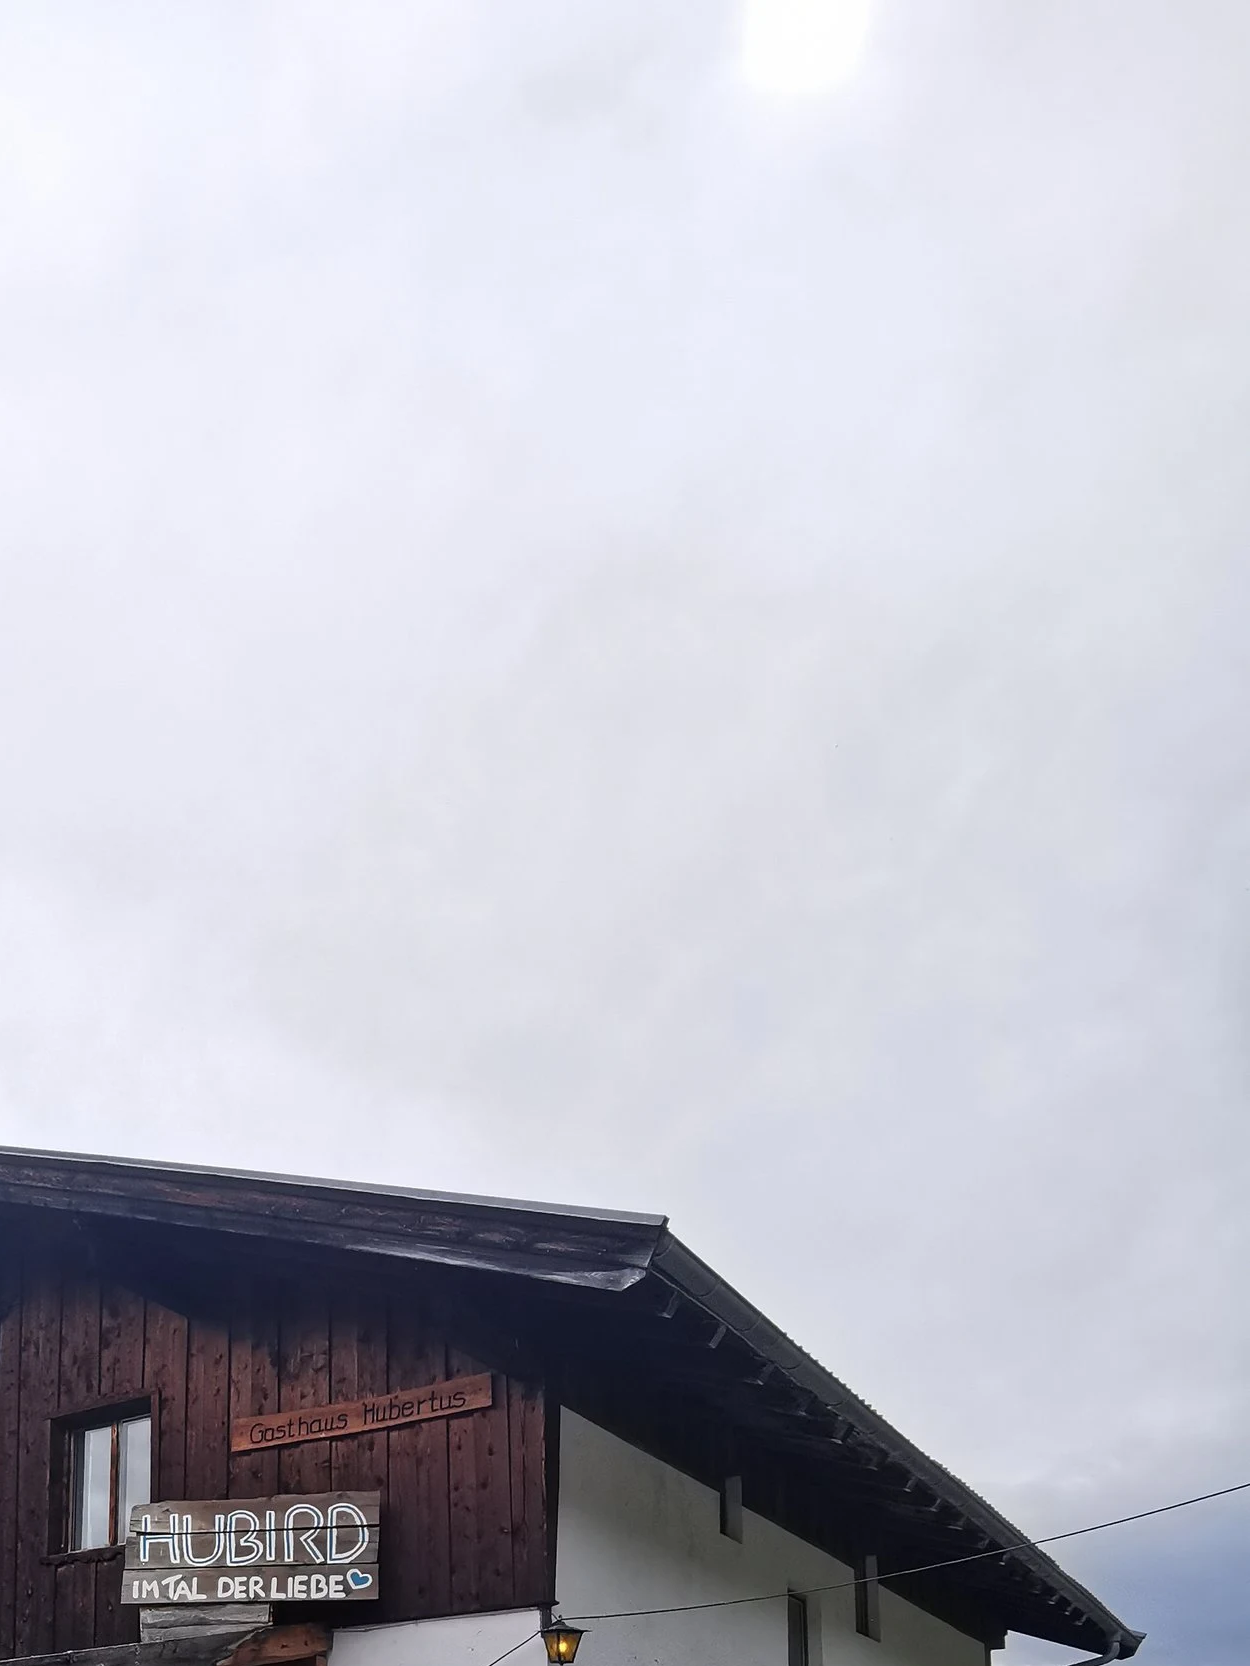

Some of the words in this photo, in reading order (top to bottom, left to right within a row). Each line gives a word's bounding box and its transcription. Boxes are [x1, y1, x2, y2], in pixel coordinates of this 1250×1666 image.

[250, 1411, 349, 1444] Gasthaus
[362, 1390, 467, 1426] Hubertus
[139, 1502, 370, 1567] HUBIRD
[132, 1580, 160, 1599] IM
[161, 1574, 207, 1601] TAL
[217, 1575, 266, 1600] DER
[270, 1574, 347, 1600] LIEBE
